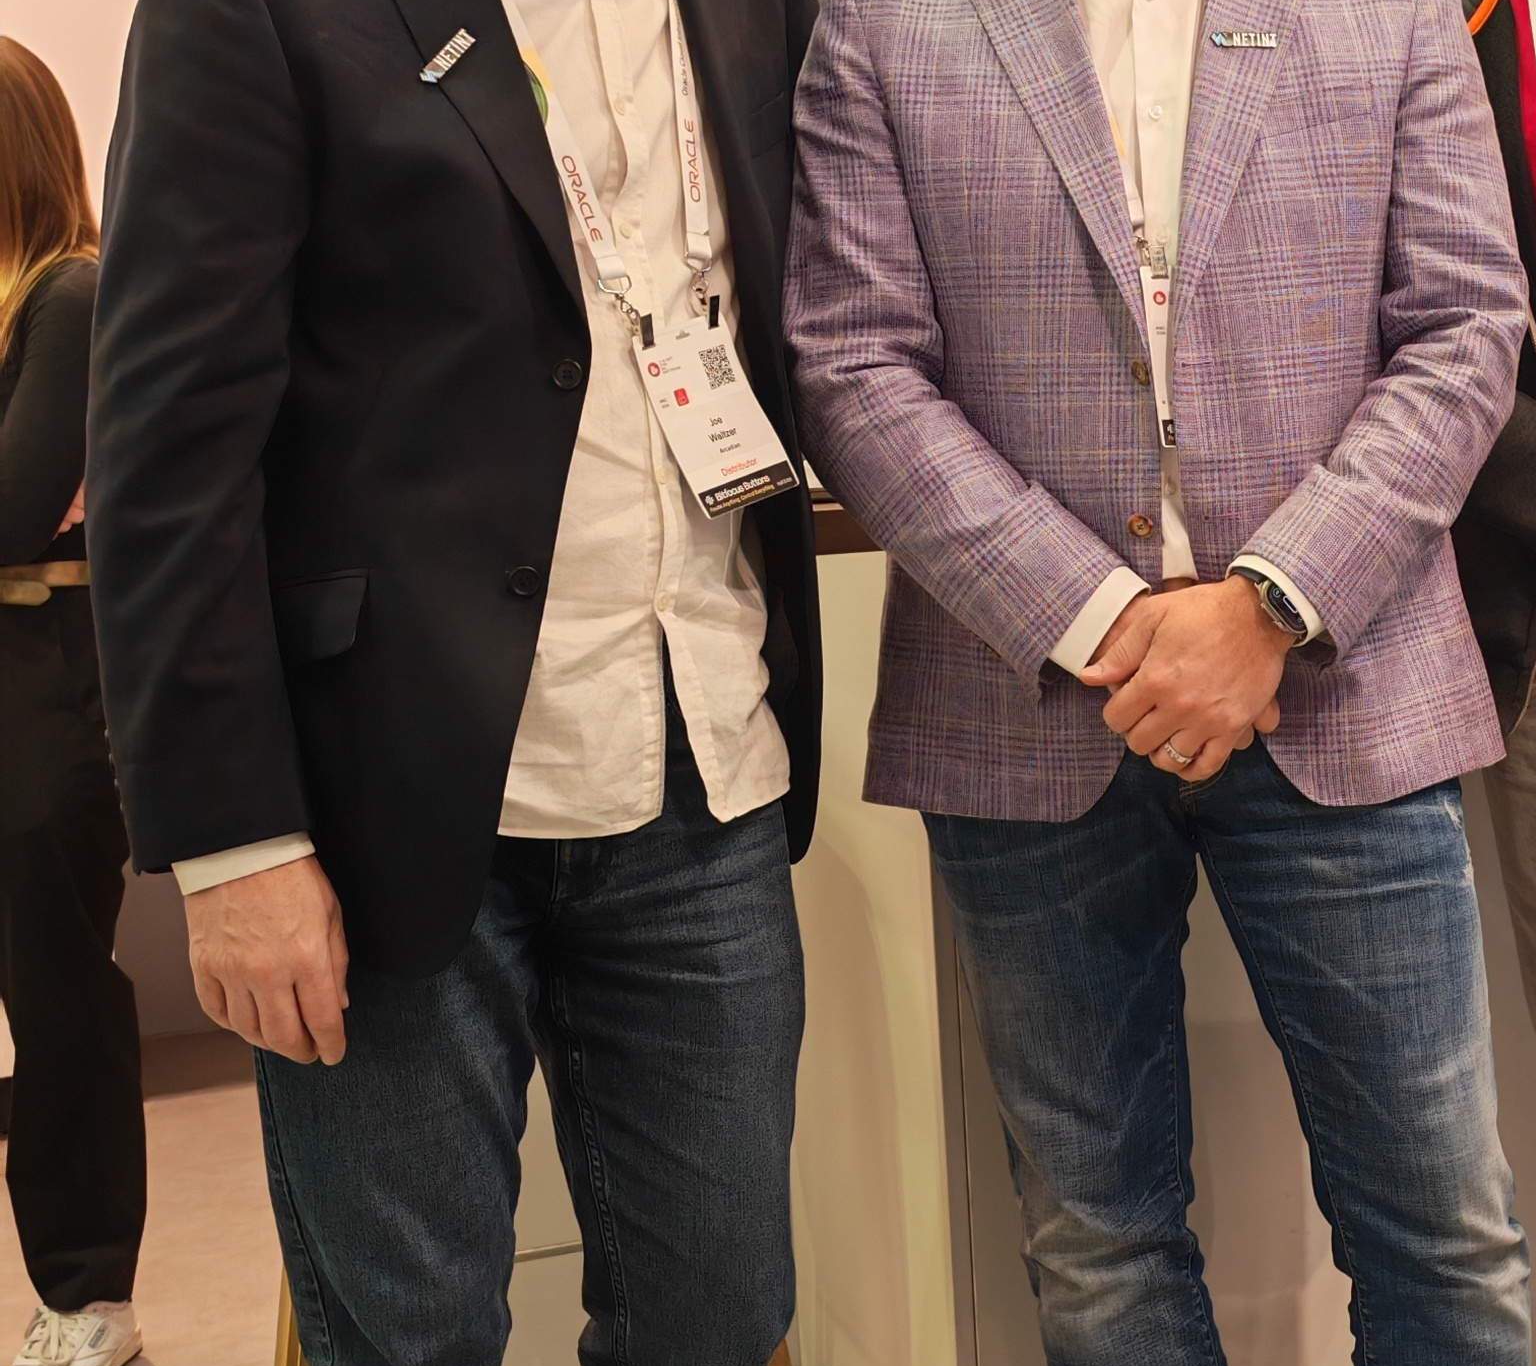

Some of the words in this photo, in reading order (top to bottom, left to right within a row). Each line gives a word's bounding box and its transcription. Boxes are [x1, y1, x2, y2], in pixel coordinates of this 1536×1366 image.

[433, 28, 476, 71] NETINT
[1232, 32, 1277, 48] NETINT
[684, 118, 701, 203] ORACLE
[561, 155, 604, 243] ORACLE
[709, 416, 723, 427] Joe
[707, 427, 738, 443] Waltzer
[721, 457, 758, 477] Distributor
[714, 485, 745, 502] Bitfocus
[742, 475, 771, 491] Buttons
